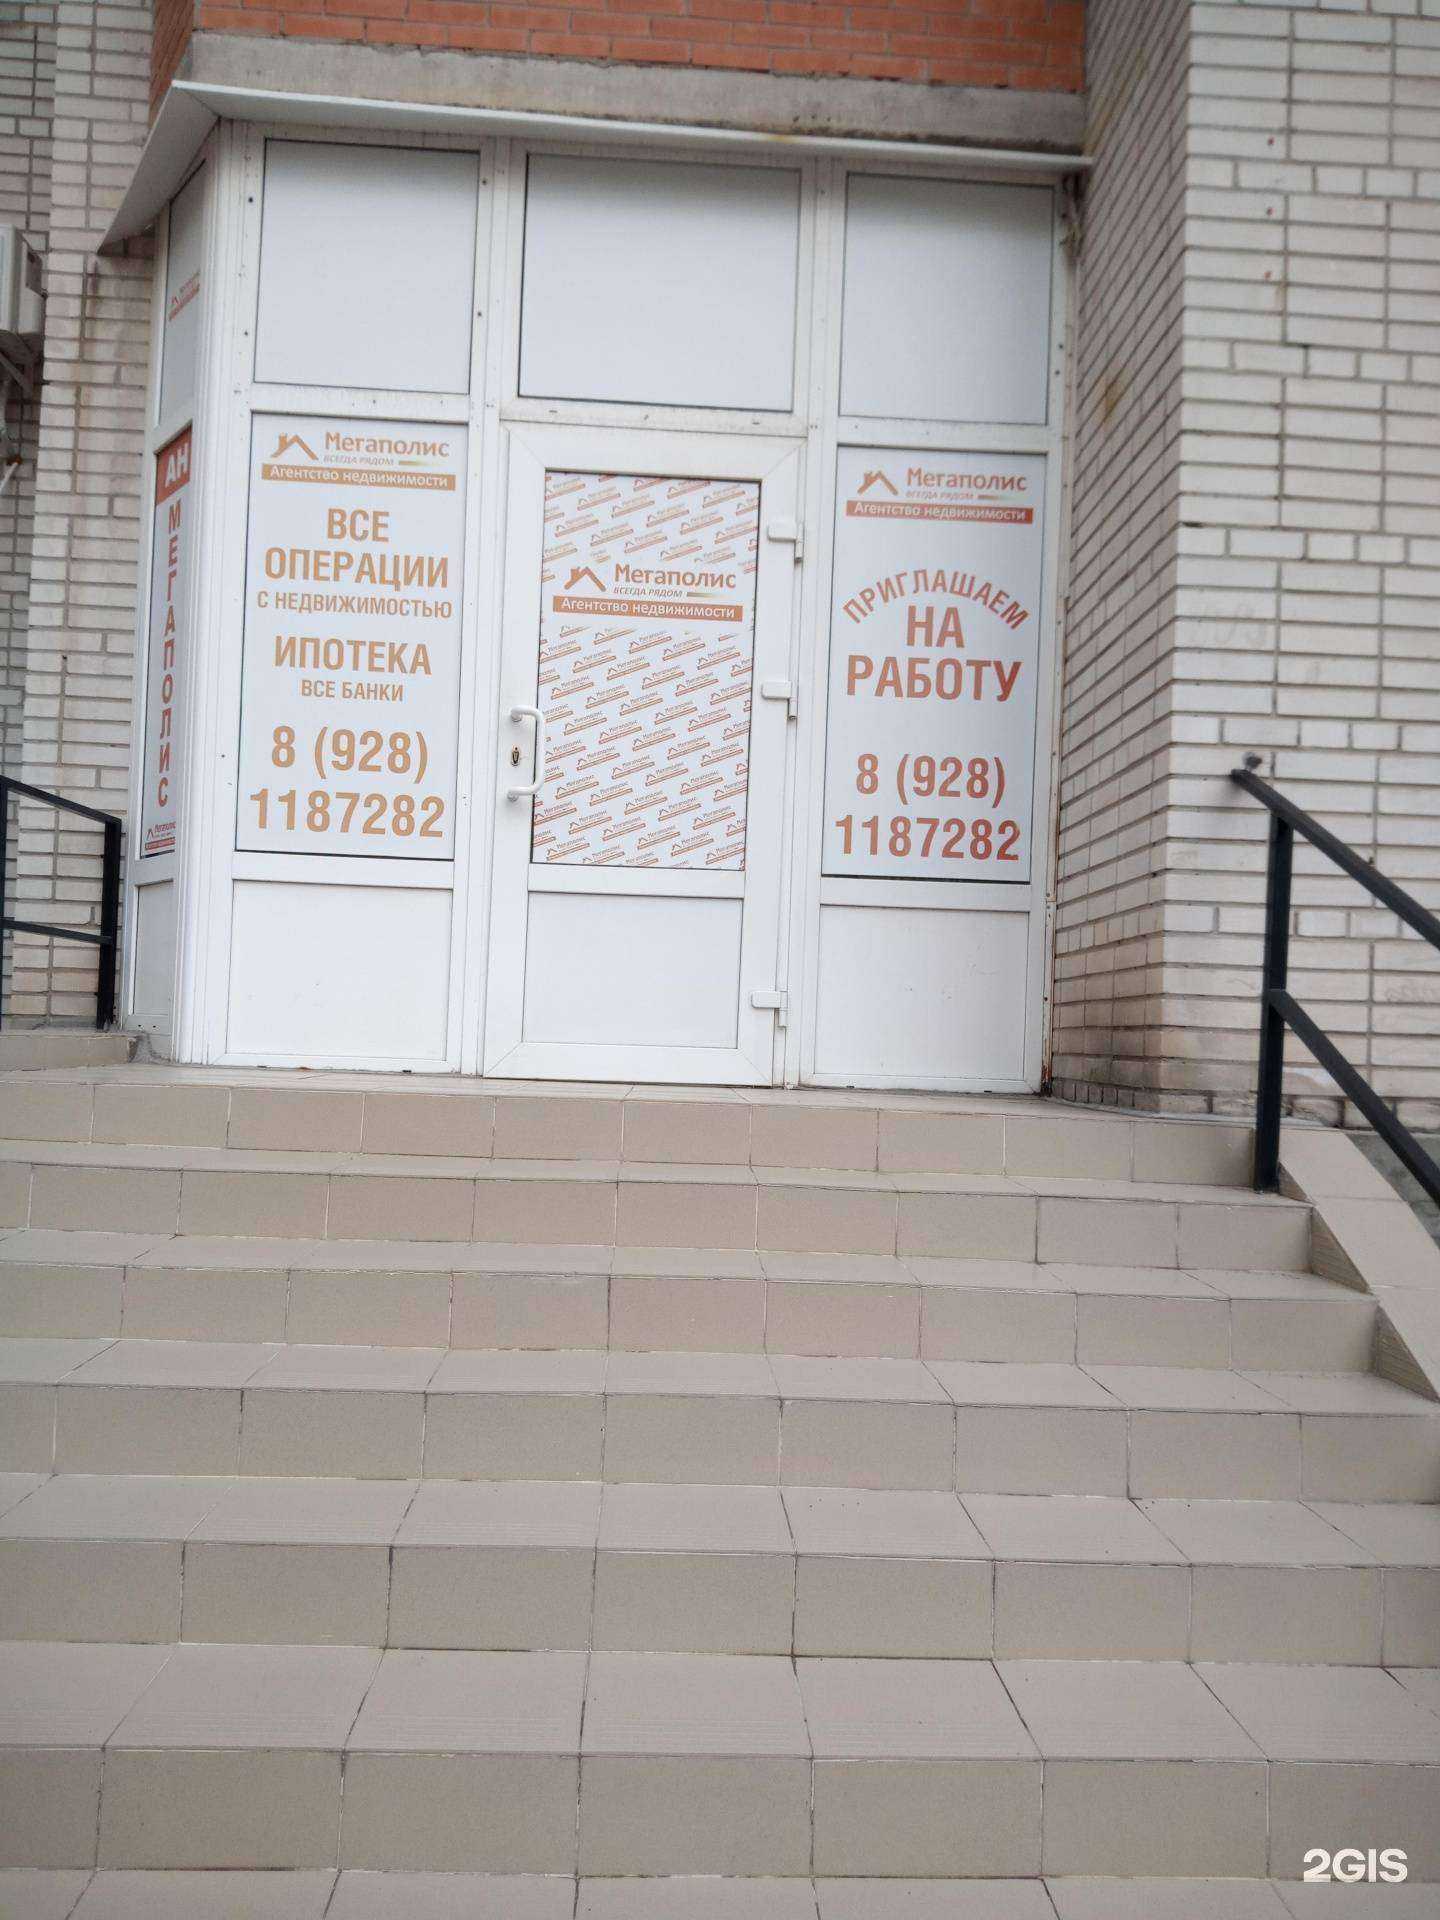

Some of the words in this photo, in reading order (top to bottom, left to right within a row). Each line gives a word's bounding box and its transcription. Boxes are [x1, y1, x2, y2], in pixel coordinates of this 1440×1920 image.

[165, 442, 189, 489] АН
[324, 431, 451, 458] Мегаполис
[270, 466, 339, 481] Агентство
[343, 470, 448, 488] недвижимости
[906, 467, 1027, 491] Мегаполис
[326, 507, 390, 543] ВСЕ
[854, 501, 921, 517] Агентство
[924, 505, 1026, 522] недвижимости
[264, 547, 449, 592] ОПЕРАЦИИ
[614, 562, 737, 589] Мегаполис
[256, 591, 269, 609] С
[275, 591, 452, 619] НЕДВИЖИМОСТЬЮ
[561, 597, 629, 613] Агентство
[632, 602, 736, 619] недвижимости
[842, 568, 1030, 631] ПРИГЛАШАЕМ
[906, 605, 966, 649] НА
[157, 499, 182, 808] МЕГАПОЛИС
[273, 635, 433, 676] ИПОТЕКА
[301, 679, 336, 699] ВСЕ
[342, 681, 404, 702] БАНКИ
[846, 654, 1024, 702] РАБОТУ
[271, 725, 296, 768] 8
[313, 726, 428, 784] (928)
[856, 753, 879, 795] 8
[896, 753, 1006, 809] (928)
[249, 788, 445, 838] 1187282
[834, 814, 1021, 861] 1187282
